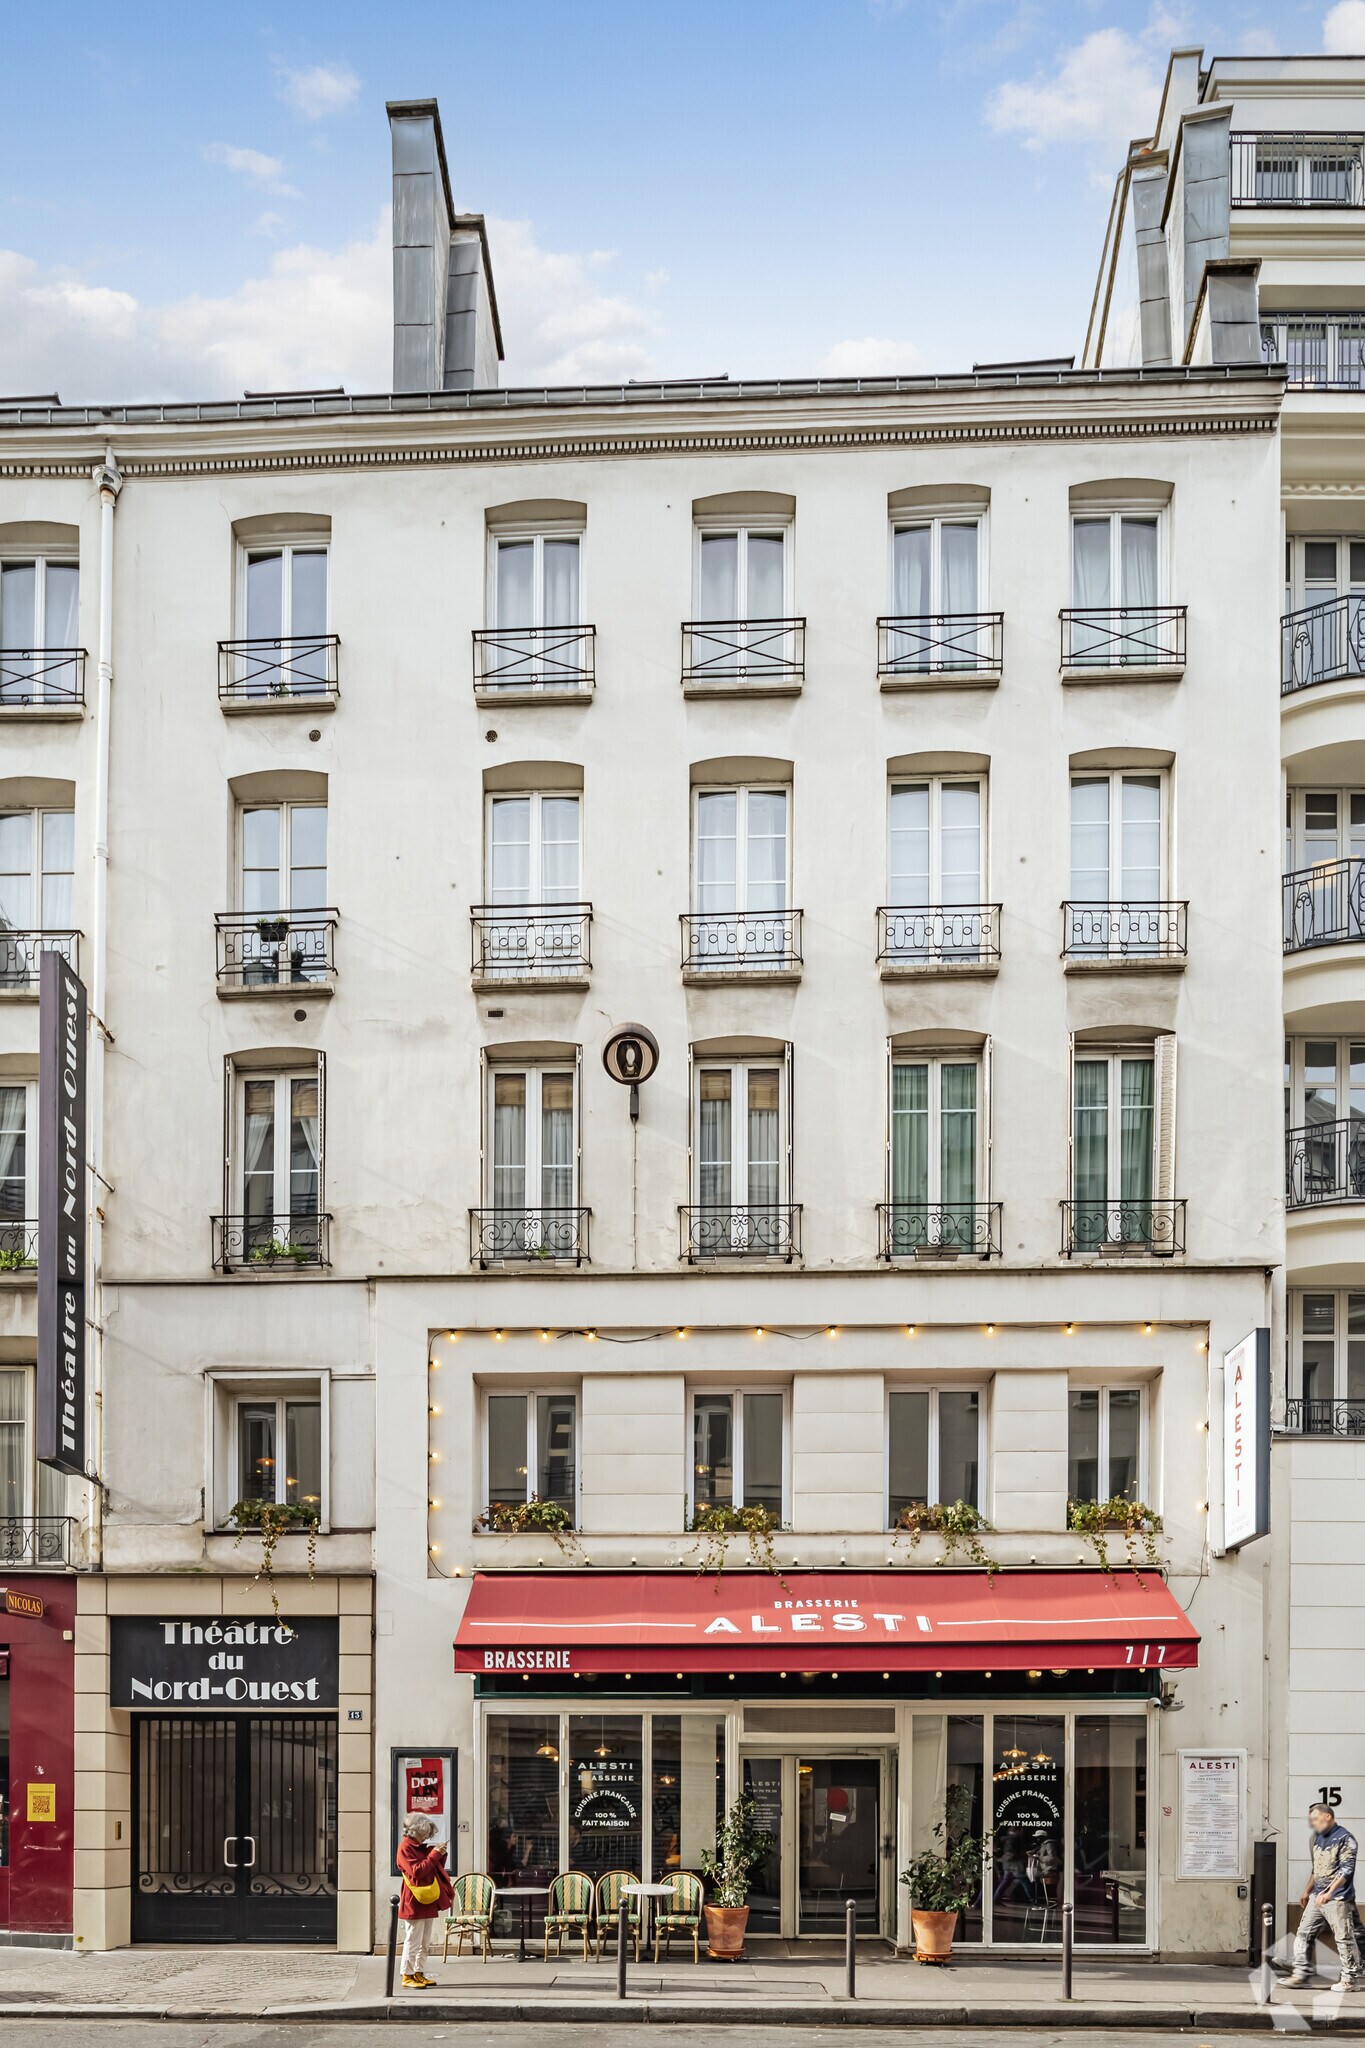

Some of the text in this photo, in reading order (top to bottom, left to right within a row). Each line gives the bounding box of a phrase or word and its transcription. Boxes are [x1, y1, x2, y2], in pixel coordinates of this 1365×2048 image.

[62, 976, 78, 1222] Nord-Ouest
[66, 1234, 77, 1276] du
[1234, 1365, 1243, 1507] ALESTI
[8, 1594, 41, 1613] NICOLAS
[774, 1599, 859, 1609] BRASSERIE
[159, 1620, 294, 1645] Théâtre
[703, 1612, 934, 1634] ALESTI
[208, 1651, 244, 1671] du
[484, 1650, 571, 1669] BRASSERIE
[131, 1677, 320, 1701] Nord-Ouest
[350, 1711, 360, 1719] 13
[577, 1762, 633, 1770] ALESTI
[1000, 1762, 1056, 1770] ALESTI
[1189, 1762, 1236, 1770] ALESTI
[574, 1790, 599, 1818] CUISINE
[996, 1791, 1021, 1818] CUISINE
[1318, 1786, 1343, 1807] 15
